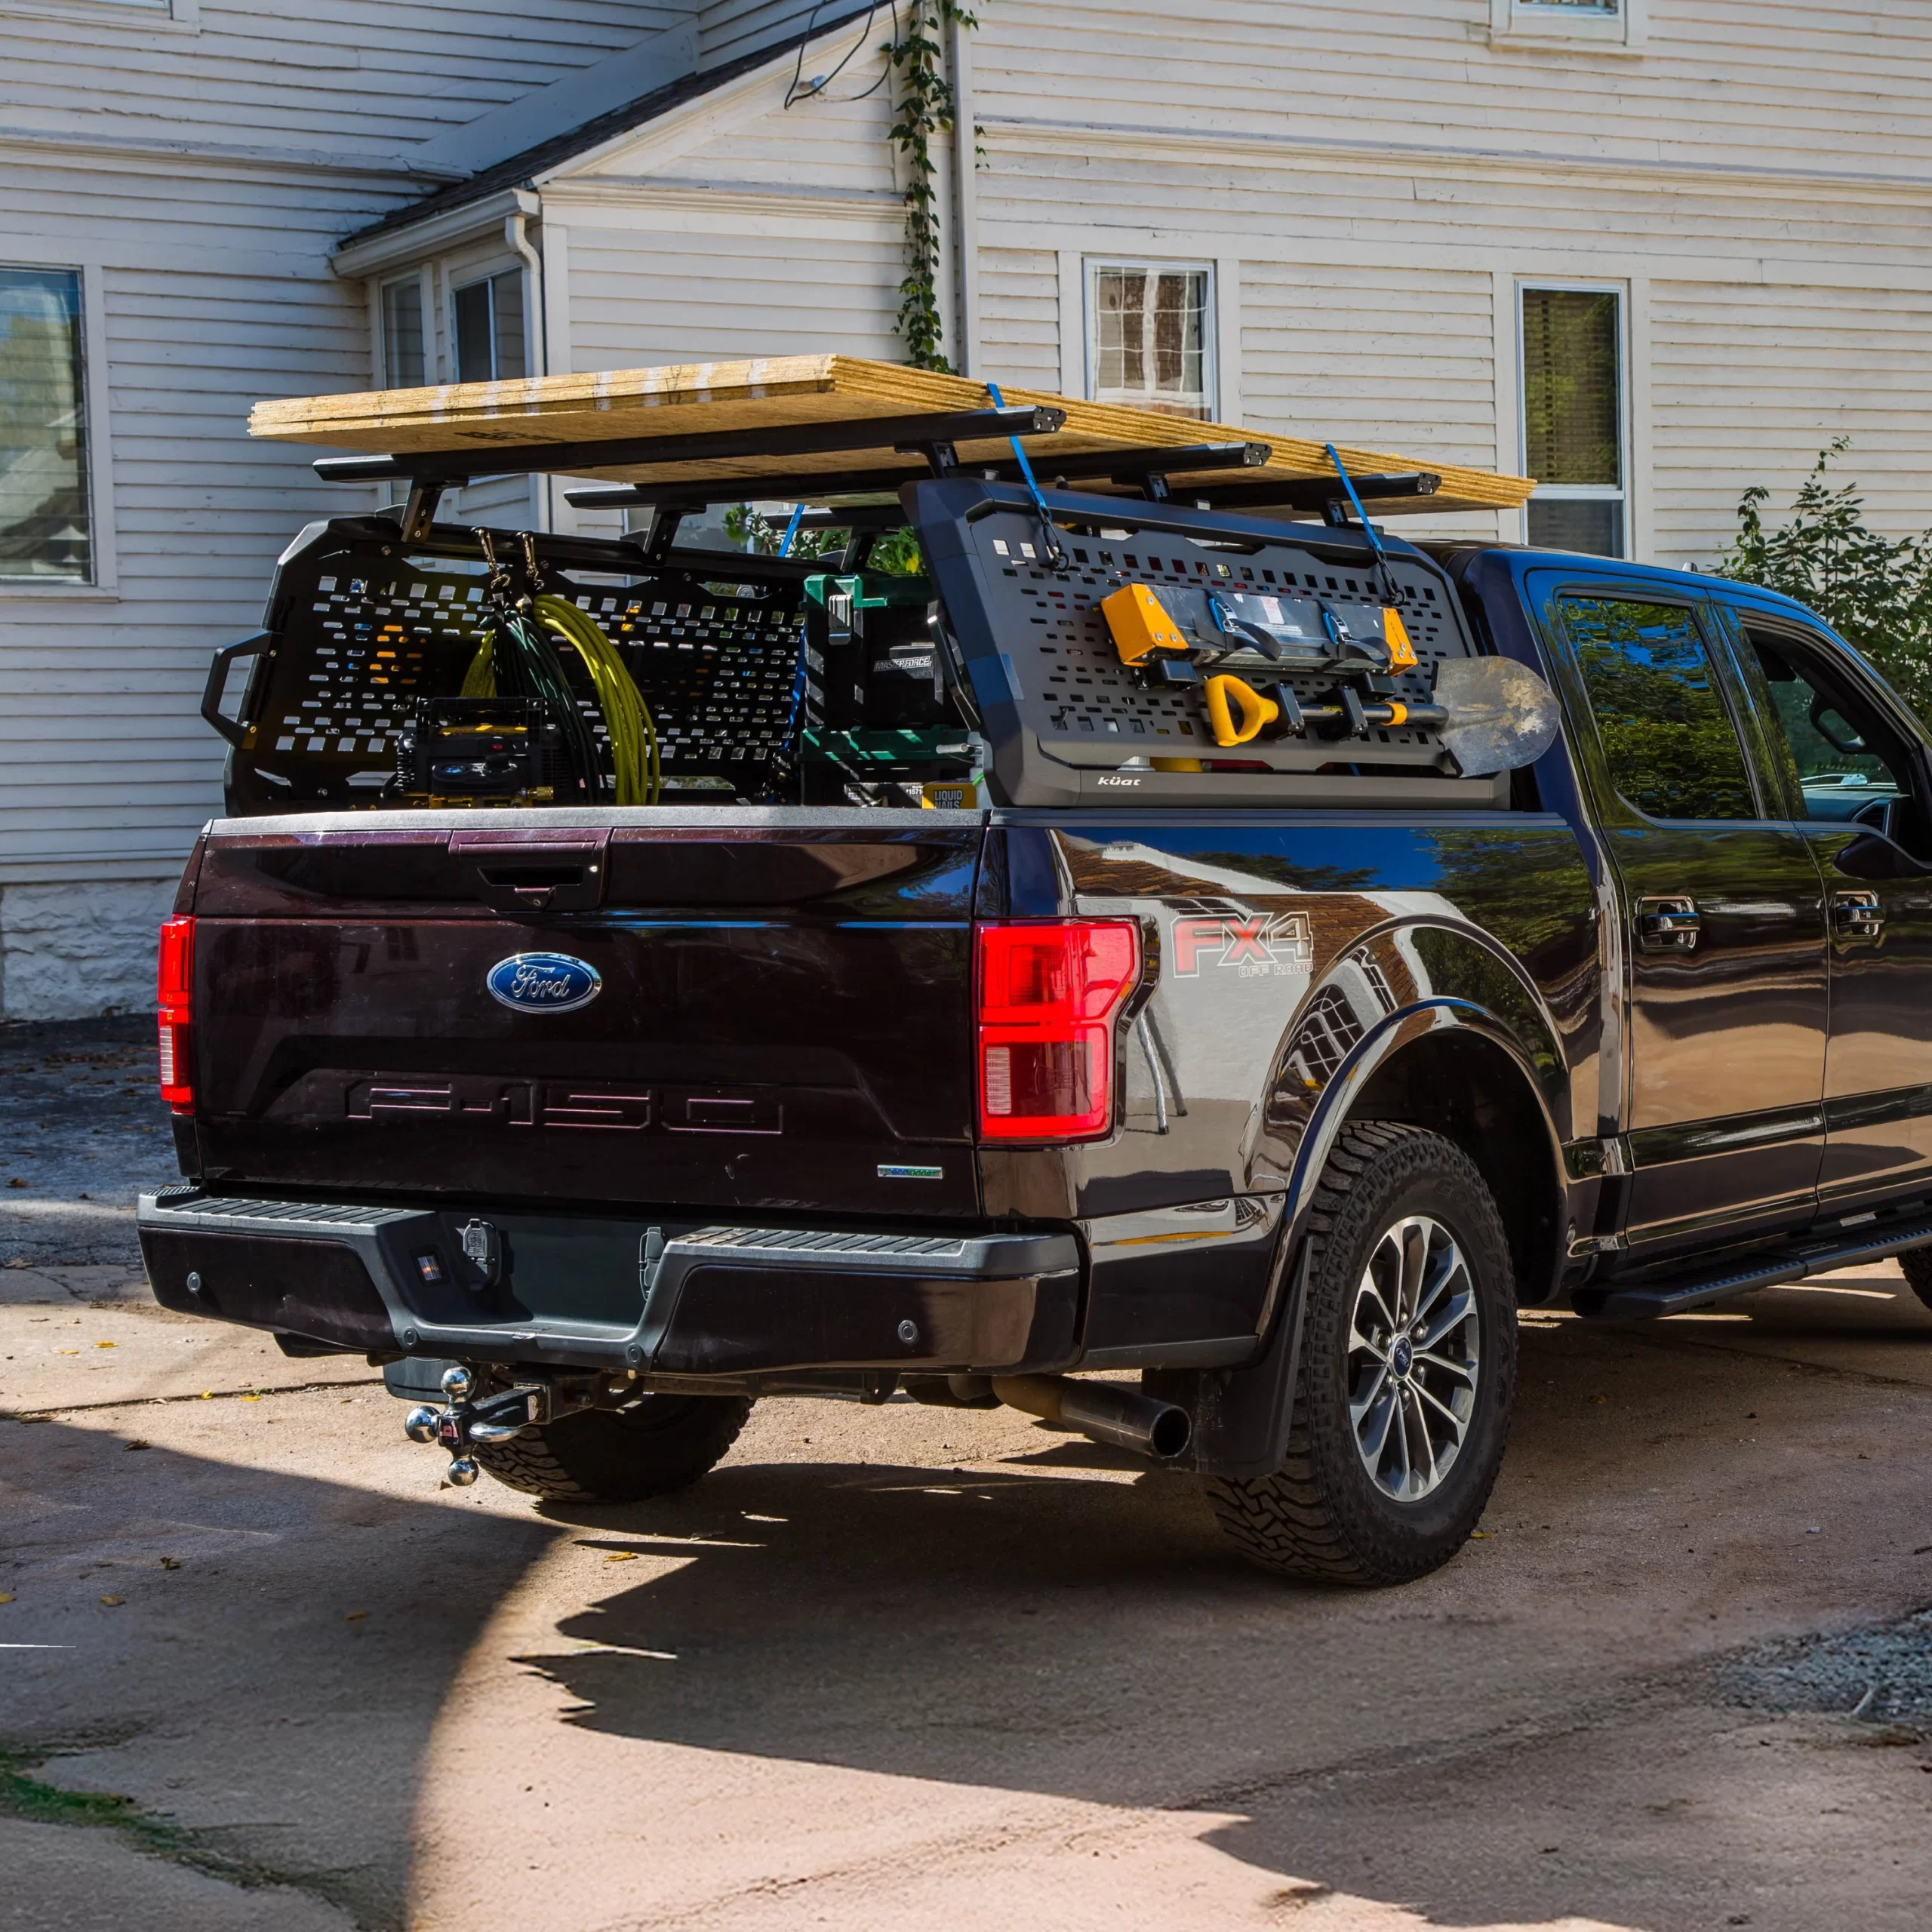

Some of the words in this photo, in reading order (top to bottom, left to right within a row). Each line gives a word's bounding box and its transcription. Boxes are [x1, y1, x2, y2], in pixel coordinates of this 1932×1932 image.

[934, 789, 963, 801] LIQUID
[1097, 777, 1141, 786] küat
[1171, 912, 1314, 978] FX4
[511, 964, 571, 998] Ford
[1238, 965, 1269, 977] OFF
[1274, 962, 1314, 975] ROAD
[346, 1081, 783, 1134] F-150
[1435, 1177, 1509, 1409] GOODYEAR
